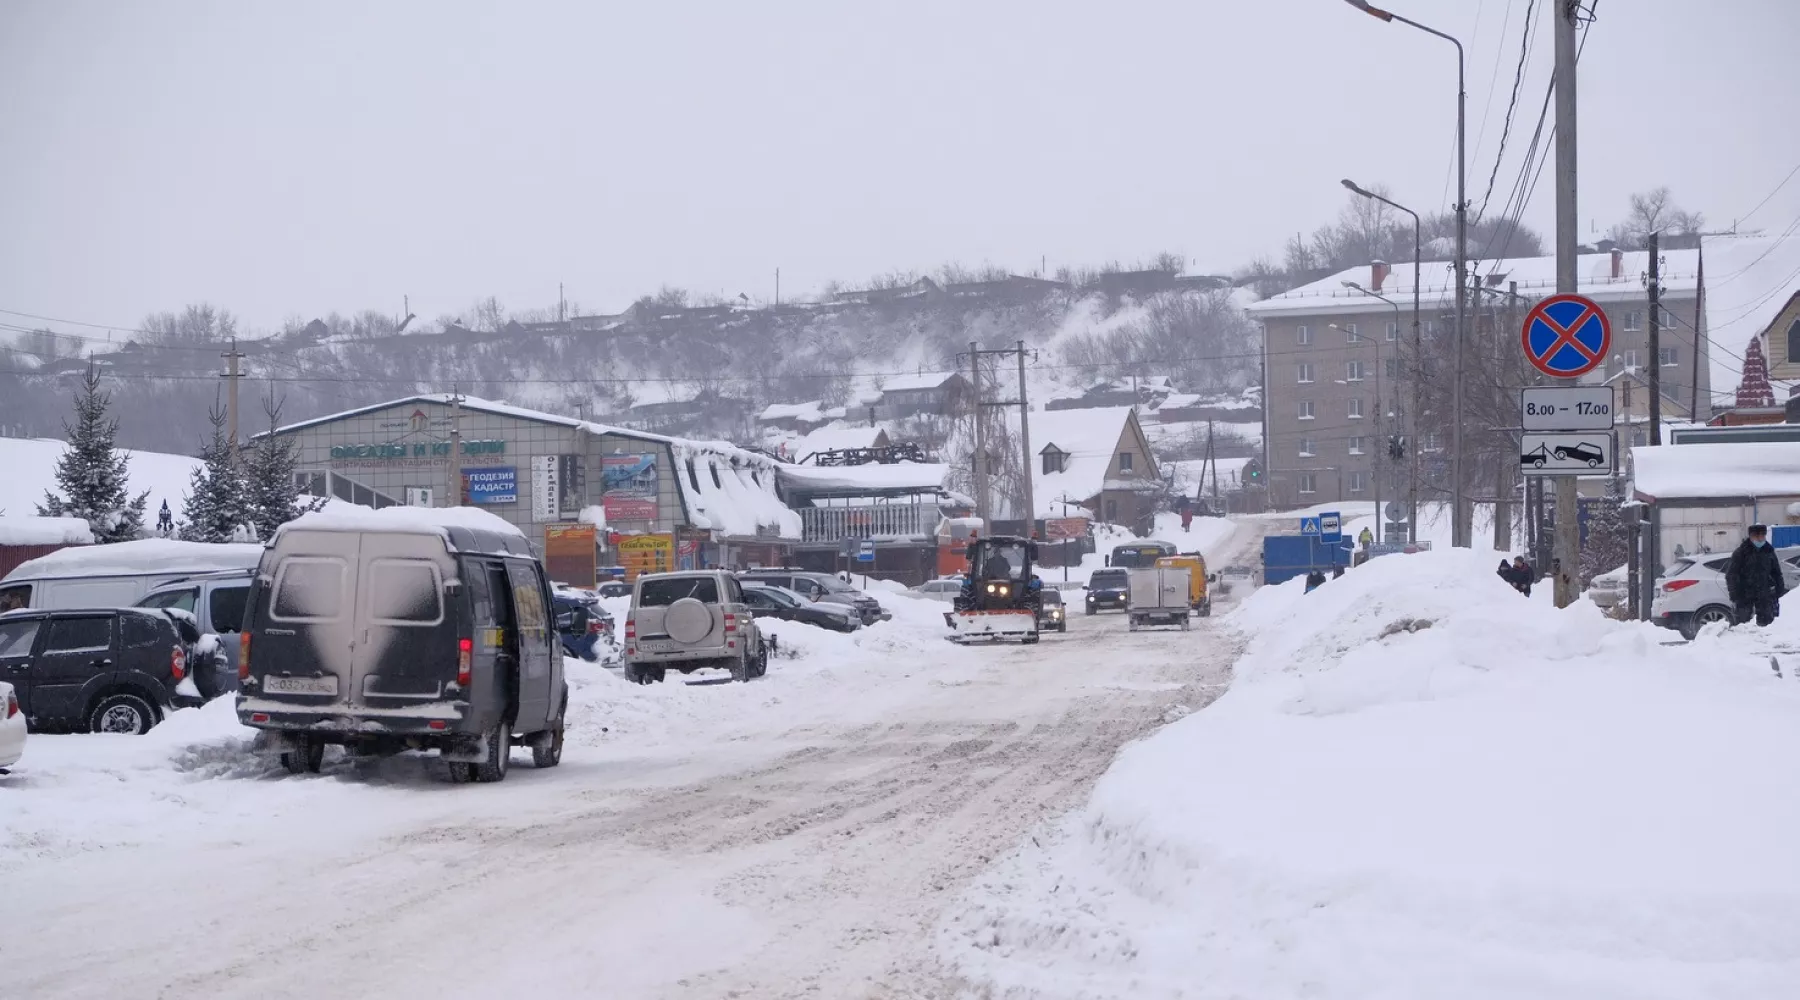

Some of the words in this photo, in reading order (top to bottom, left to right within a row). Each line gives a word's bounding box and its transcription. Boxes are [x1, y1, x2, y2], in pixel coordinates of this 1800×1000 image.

[1526, 402, 1555, 416] 8.00
[1575, 402, 1609, 416] 17.00
[469, 472, 514, 482] ГЕОДЕЗИЯ
[474, 482, 515, 492] КАДАСТР
[547, 456, 557, 515] ОГРАЖДЕНИЯ
